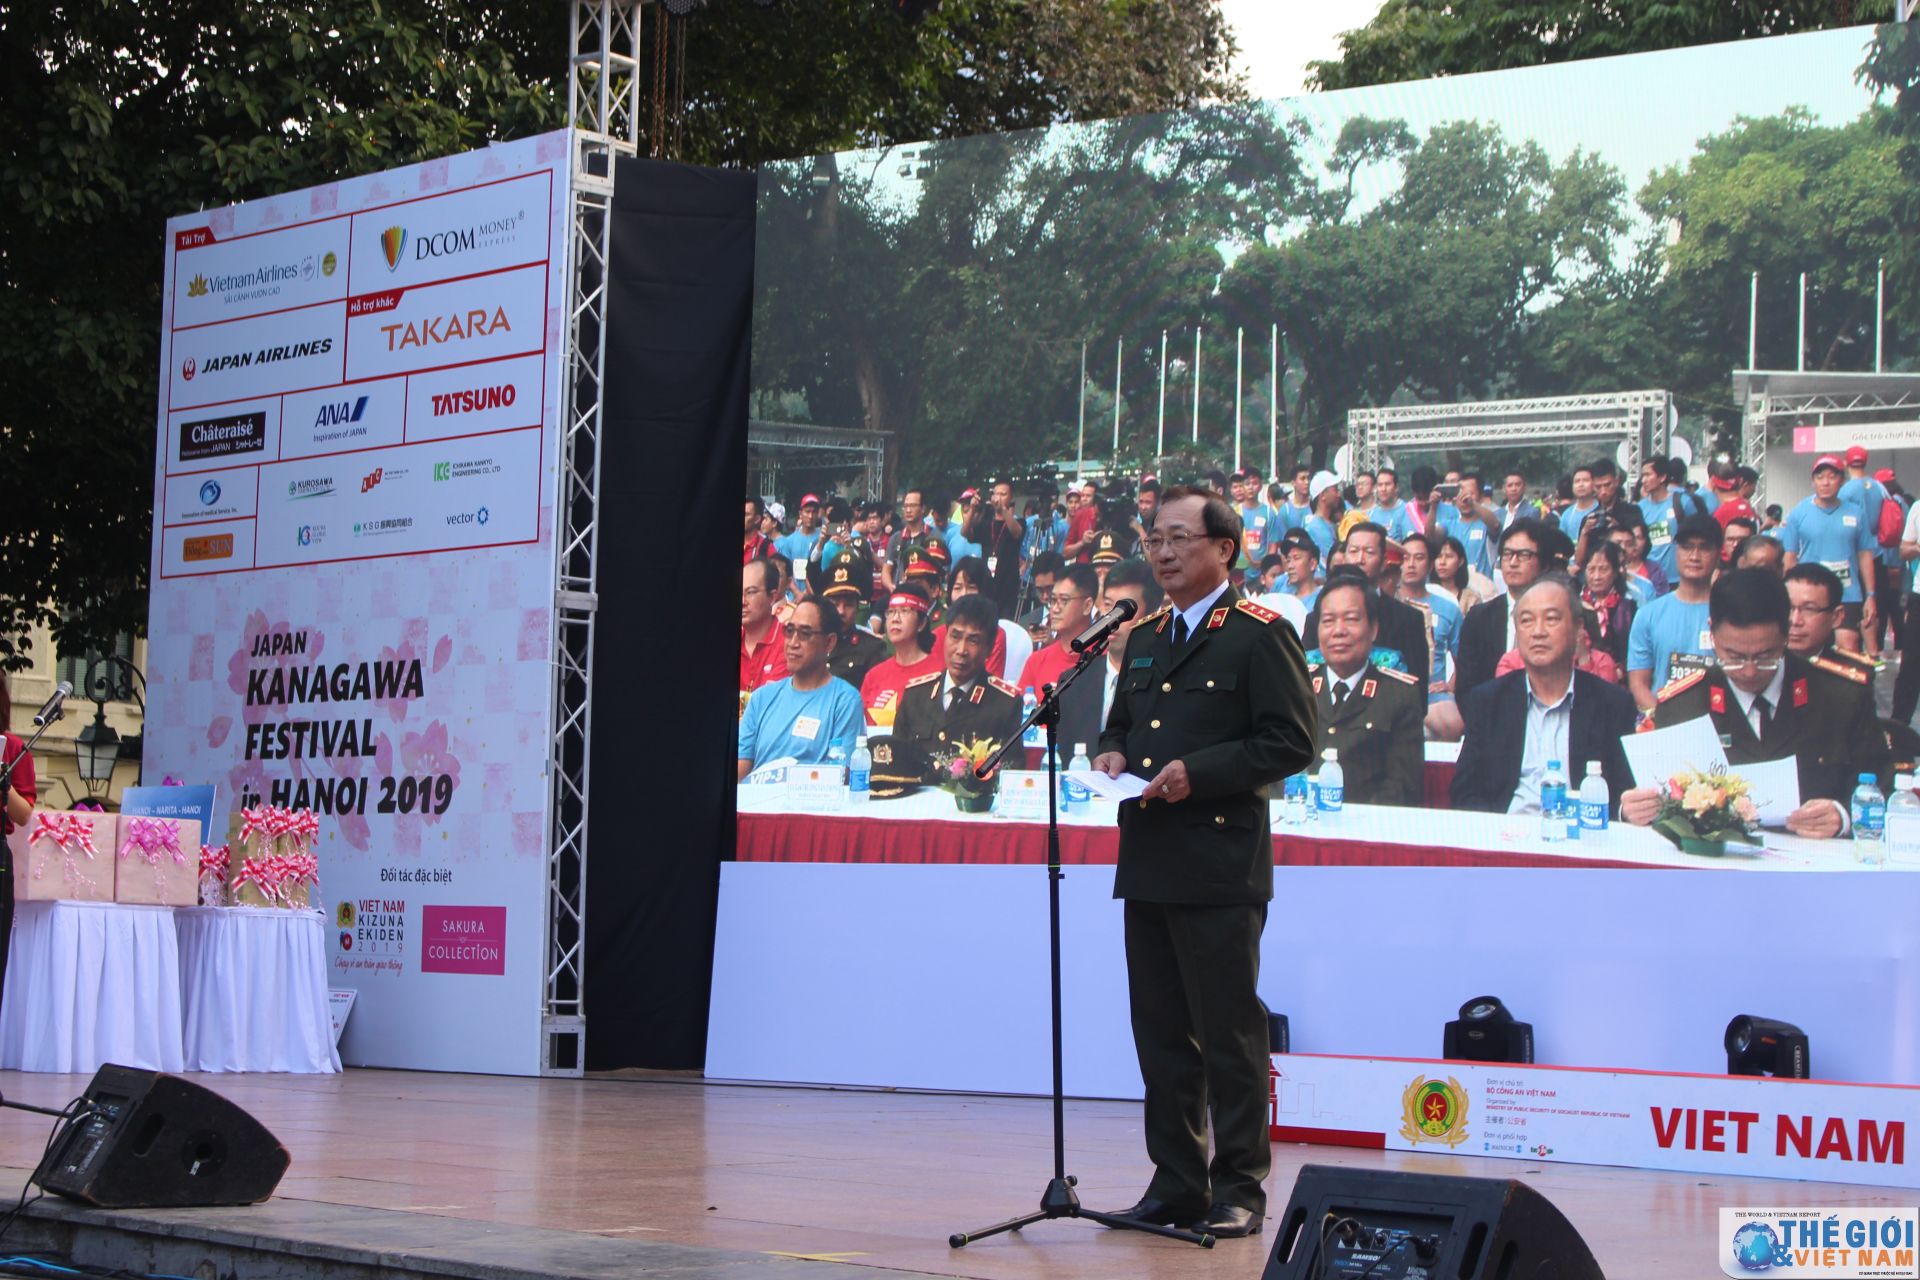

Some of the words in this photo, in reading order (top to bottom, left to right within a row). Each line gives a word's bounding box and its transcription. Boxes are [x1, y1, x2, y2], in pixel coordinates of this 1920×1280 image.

[478, 216, 518, 237] MONEY
[415, 227, 476, 261] DCOM
[209, 273, 255, 294] Vietnam
[255, 264, 298, 286] Airlines
[376, 295, 394, 309] khác
[380, 305, 512, 352] TAKARA
[201, 352, 252, 375] JAPAN
[254, 338, 333, 365] AIRLINES
[431, 383, 516, 417] TATSUNO
[314, 401, 350, 428] ANA
[191, 417, 254, 444] Châteraisé
[313, 431, 341, 444] Inspiration
[342, 430, 348, 438] of
[348, 427, 367, 438] JAPAN
[297, 476, 333, 490] KUROSAWA
[452, 468, 481, 478] ENGINEERING
[446, 512, 474, 526] vector
[250, 631, 308, 657] JAPAN
[246, 659, 424, 706] KANAGAWA
[244, 718, 377, 761] FESTIVAL
[241, 784, 261, 811] in
[270, 776, 369, 816] HANOI
[377, 773, 454, 815] 2019
[156, 805, 178, 815] NARITA
[380, 866, 397, 882] Đối
[399, 868, 412, 882] tác
[414, 868, 431, 885] đặc
[433, 868, 453, 885] biệt
[359, 899, 381, 913] VIET
[382, 899, 405, 914] NAM
[358, 914, 404, 928] KIZUNA
[442, 919, 485, 933] SAKURA
[357, 928, 404, 942] EKIDEN
[1515, 1089, 1525, 1097] AN
[1540, 1090, 1557, 1098] NAM
[1649, 1106, 1760, 1154] VIET
[1775, 1113, 1906, 1165] NAM
